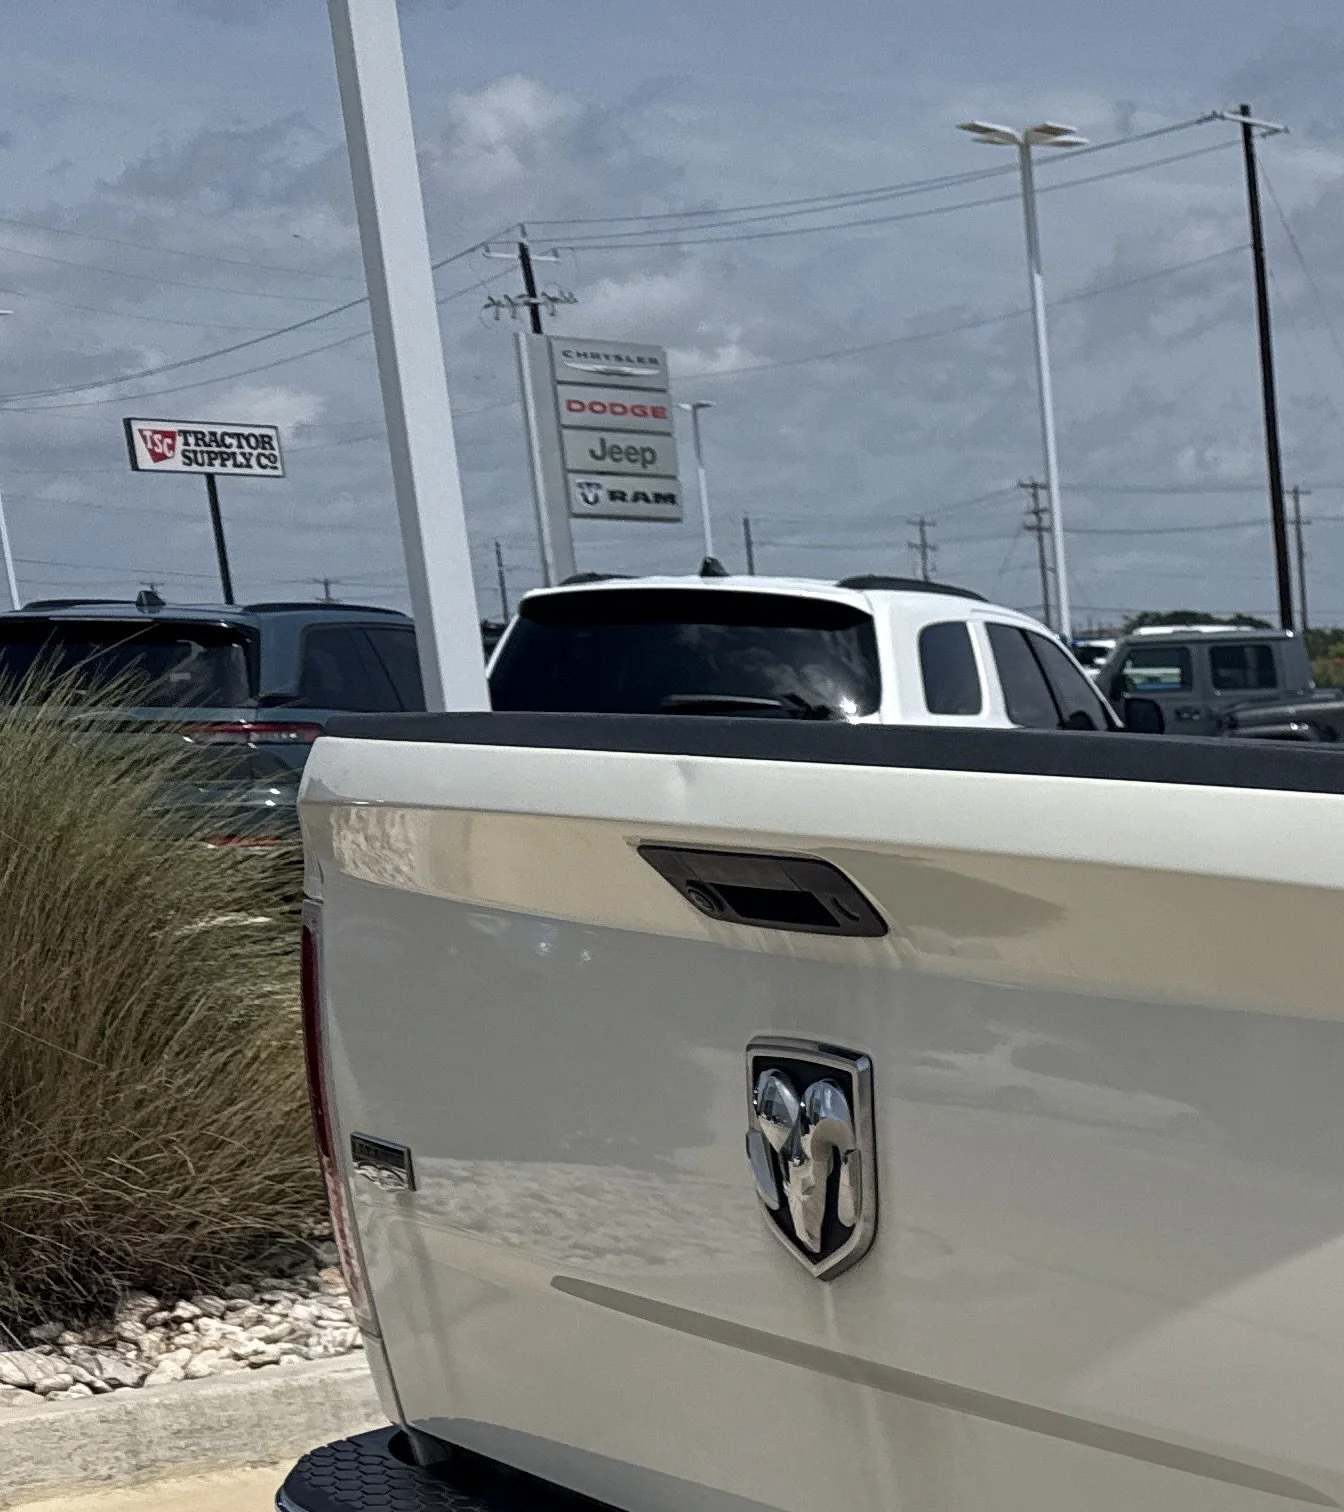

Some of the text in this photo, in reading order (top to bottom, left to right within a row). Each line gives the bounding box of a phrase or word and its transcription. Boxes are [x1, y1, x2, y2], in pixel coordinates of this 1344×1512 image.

[562, 350, 661, 366] CHRYSLER
[566, 399, 669, 420] DODGE
[142, 430, 174, 458] TSC
[178, 430, 276, 451] TRACTOR
[181, 449, 254, 469] SUPPLY
[588, 437, 657, 468] Jeep
[607, 489, 677, 505] RAM
